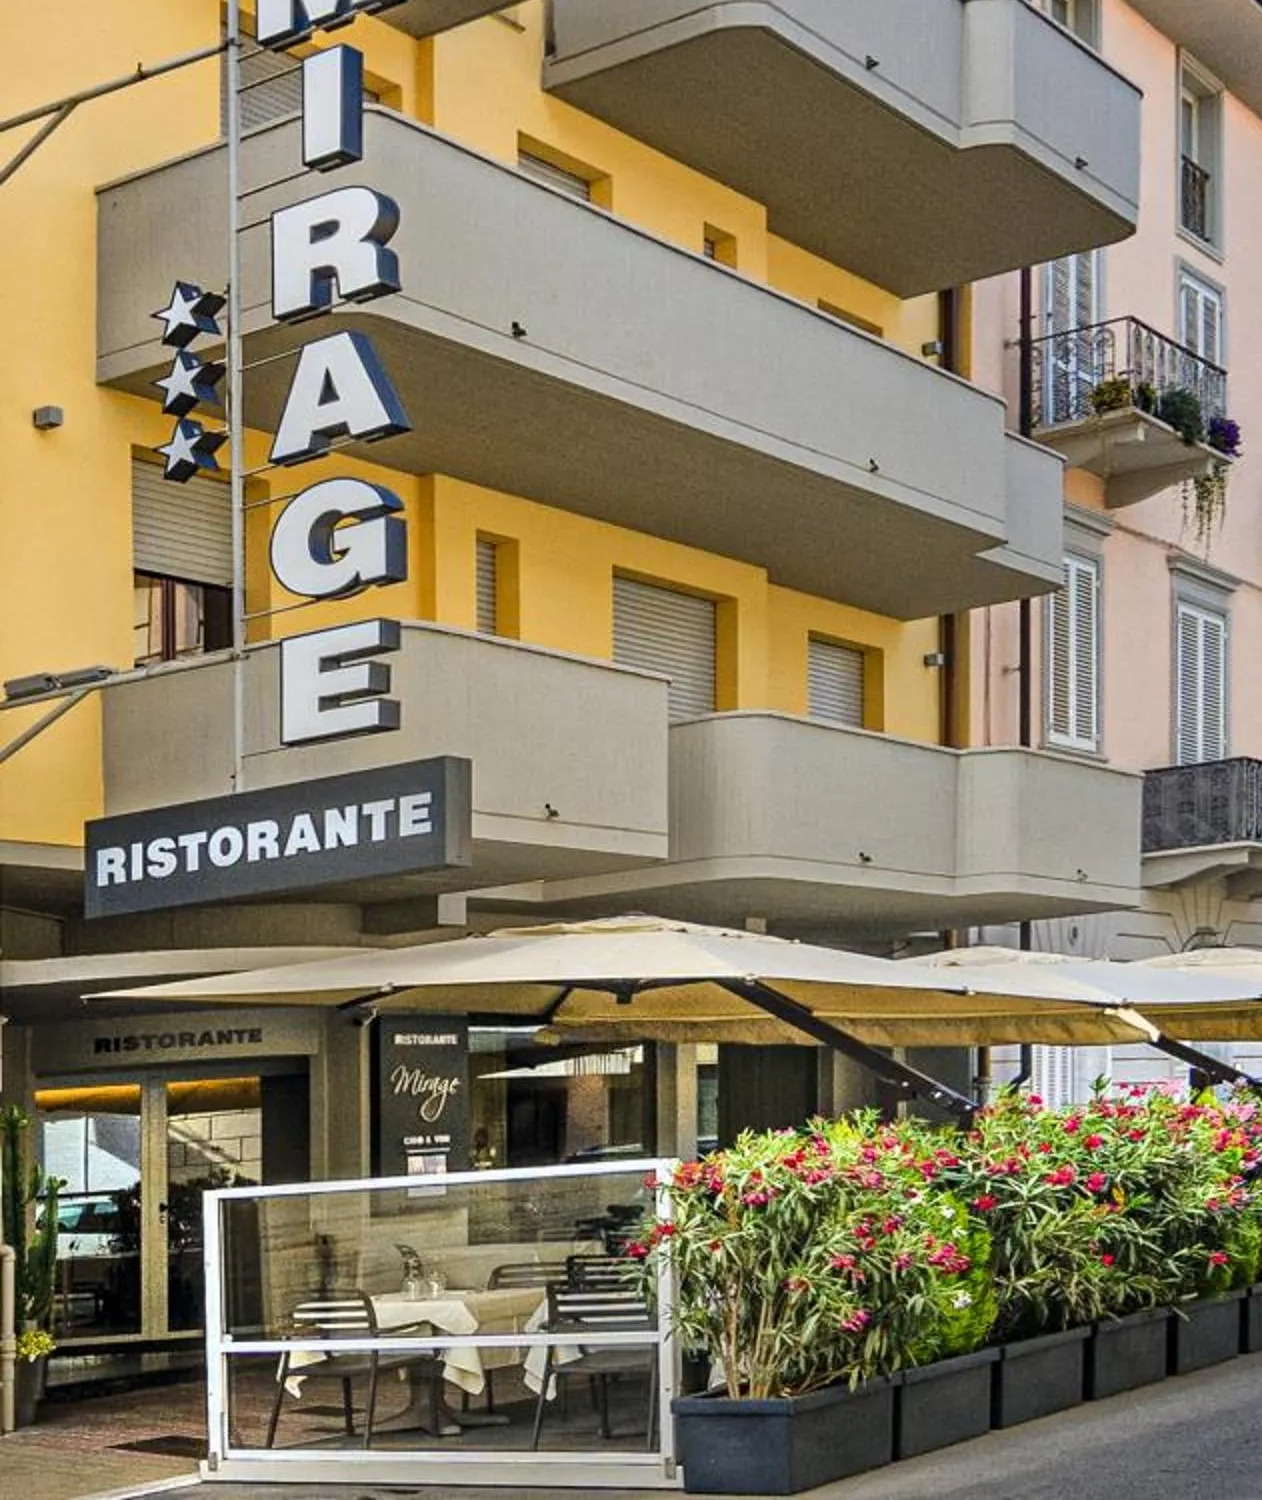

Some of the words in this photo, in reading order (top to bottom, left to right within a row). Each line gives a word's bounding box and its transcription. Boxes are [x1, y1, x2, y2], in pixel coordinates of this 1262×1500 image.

[96, 792, 432, 887] RISTORANTE
[94, 1028, 263, 1054] RISTORANTE
[394, 1034, 458, 1045] RISTORANTE
[391, 1065, 461, 1123] Mirage
